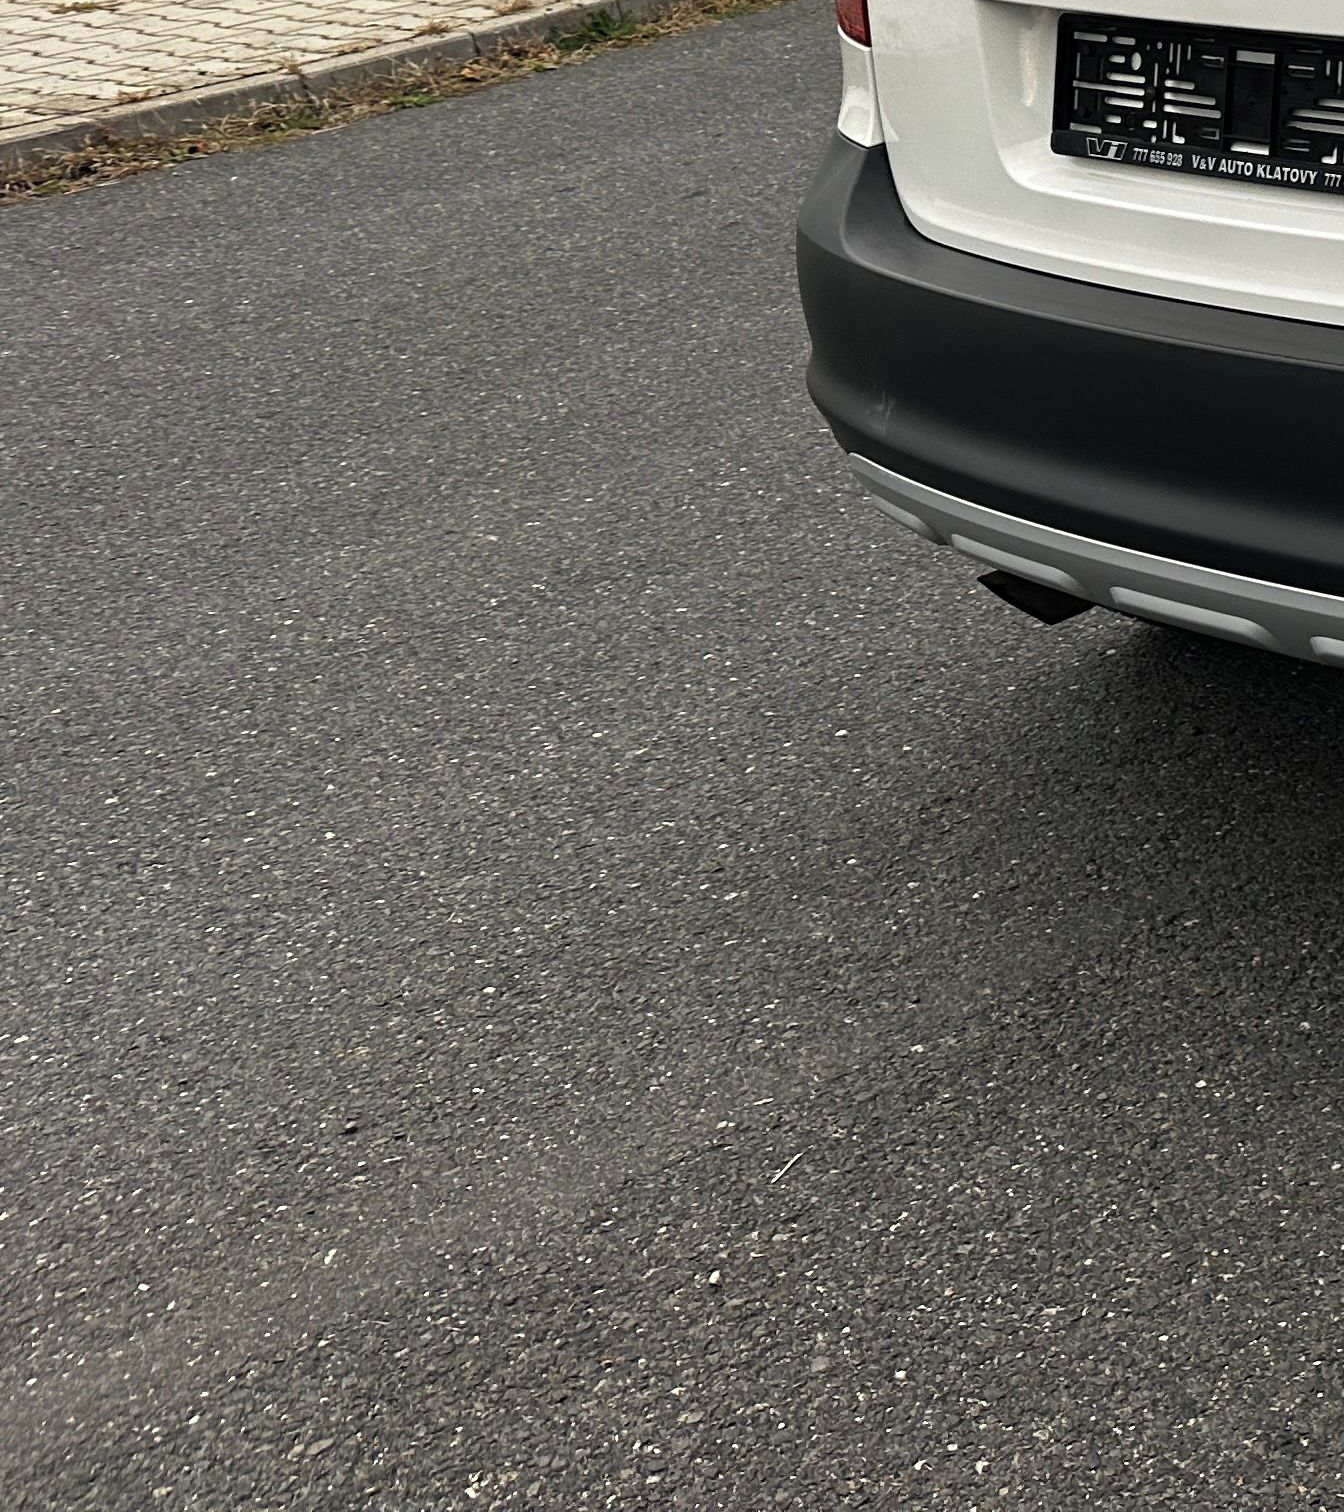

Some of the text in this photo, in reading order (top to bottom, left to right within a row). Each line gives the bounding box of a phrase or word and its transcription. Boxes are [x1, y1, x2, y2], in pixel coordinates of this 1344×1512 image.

[1132, 147, 1149, 162] 777
[1218, 158, 1254, 177] AUTO
[1256, 164, 1319, 185] KLATOVY
[1324, 172, 1342, 188] 777
